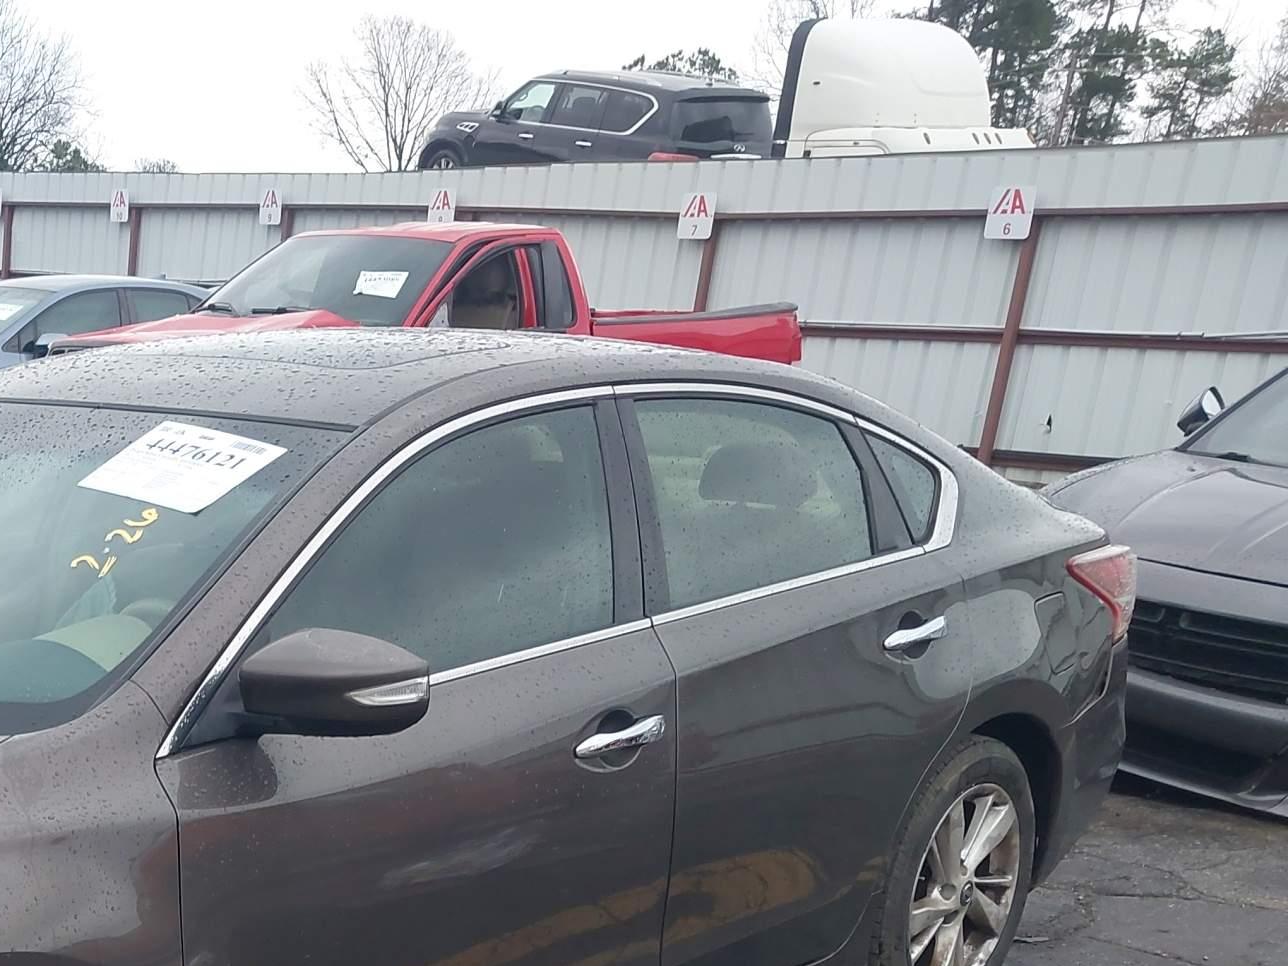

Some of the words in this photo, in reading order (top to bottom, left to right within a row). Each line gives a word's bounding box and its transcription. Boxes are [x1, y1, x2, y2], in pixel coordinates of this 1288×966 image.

[116, 212, 123, 221] 10
[267, 213, 272, 222] 9
[691, 225, 697, 236] 7
[1003, 223, 1011, 235] 6
[146, 438, 248, 470] 44476121
